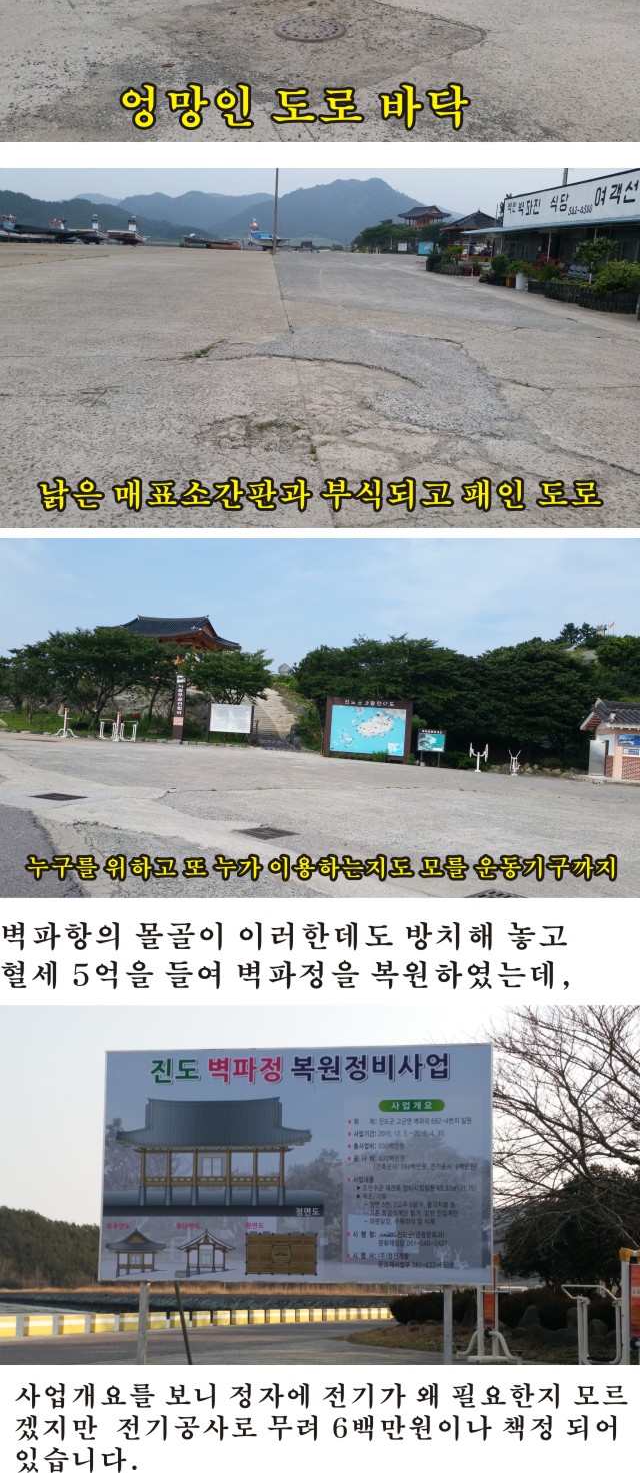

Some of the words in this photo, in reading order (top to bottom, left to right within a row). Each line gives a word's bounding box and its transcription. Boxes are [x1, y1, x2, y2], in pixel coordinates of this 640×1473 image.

[549, 193, 569, 212] 식당
[594, 180, 640, 207] 여객선
[151, 1058, 201, 1083] 진도
[207, 1056, 283, 1084] 벽파정
[290, 1052, 452, 1082] 복원정비사업
[391, 1101, 433, 1110] 사업개요
[295, 1207, 320, 1217] 정면도
